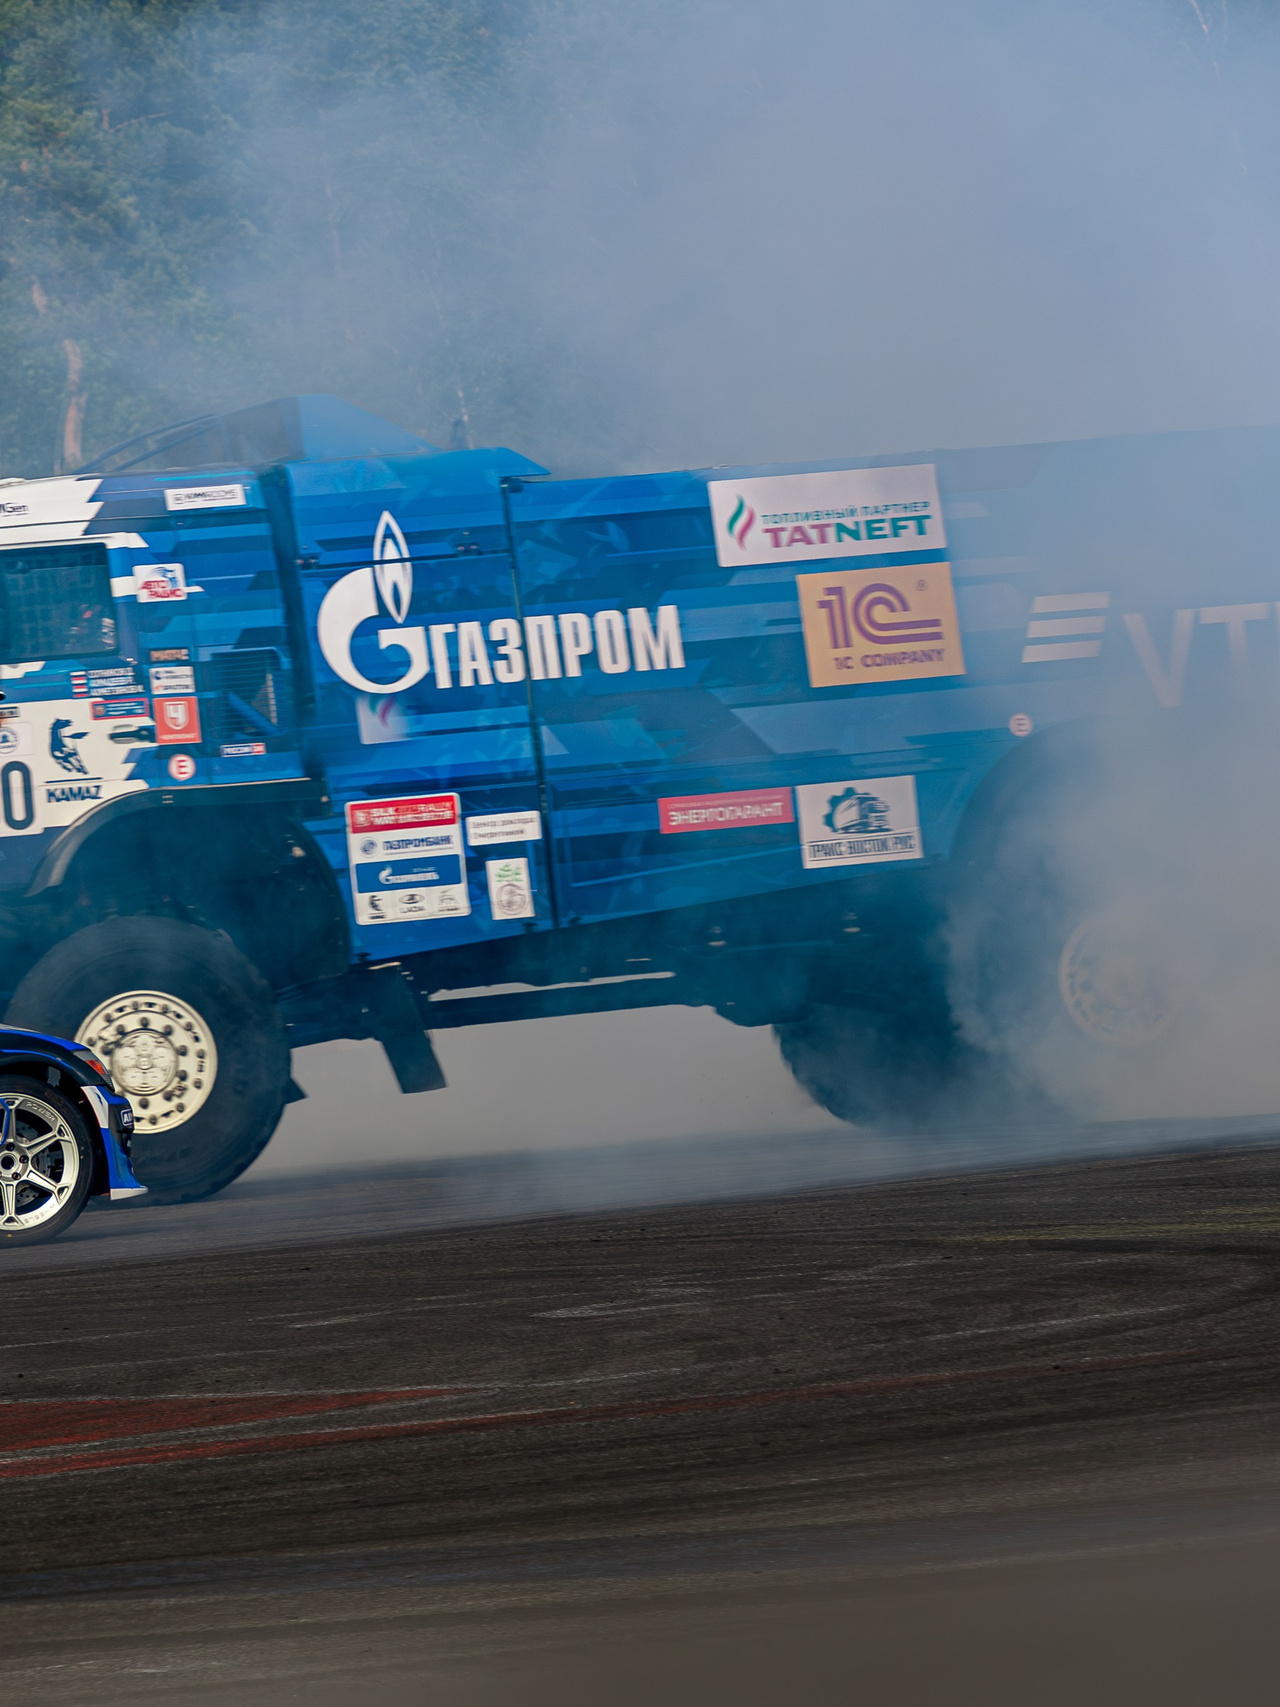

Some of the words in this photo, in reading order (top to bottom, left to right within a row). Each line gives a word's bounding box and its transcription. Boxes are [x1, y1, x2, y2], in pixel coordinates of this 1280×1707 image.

[761, 505, 858, 525] ТОПЛИВНЫЙ
[860, 501, 931, 516] ПАРТНЕР
[761, 514, 932, 548] TATNEFT
[428, 604, 686, 689] ГАЗПРОМ
[861, 648, 946, 669] COMPANY
[1122, 600, 1280, 708] VT
[46, 785, 103, 803] KAMAZ
[668, 802, 784, 826] ЭНЕРГОГАРАНТ
